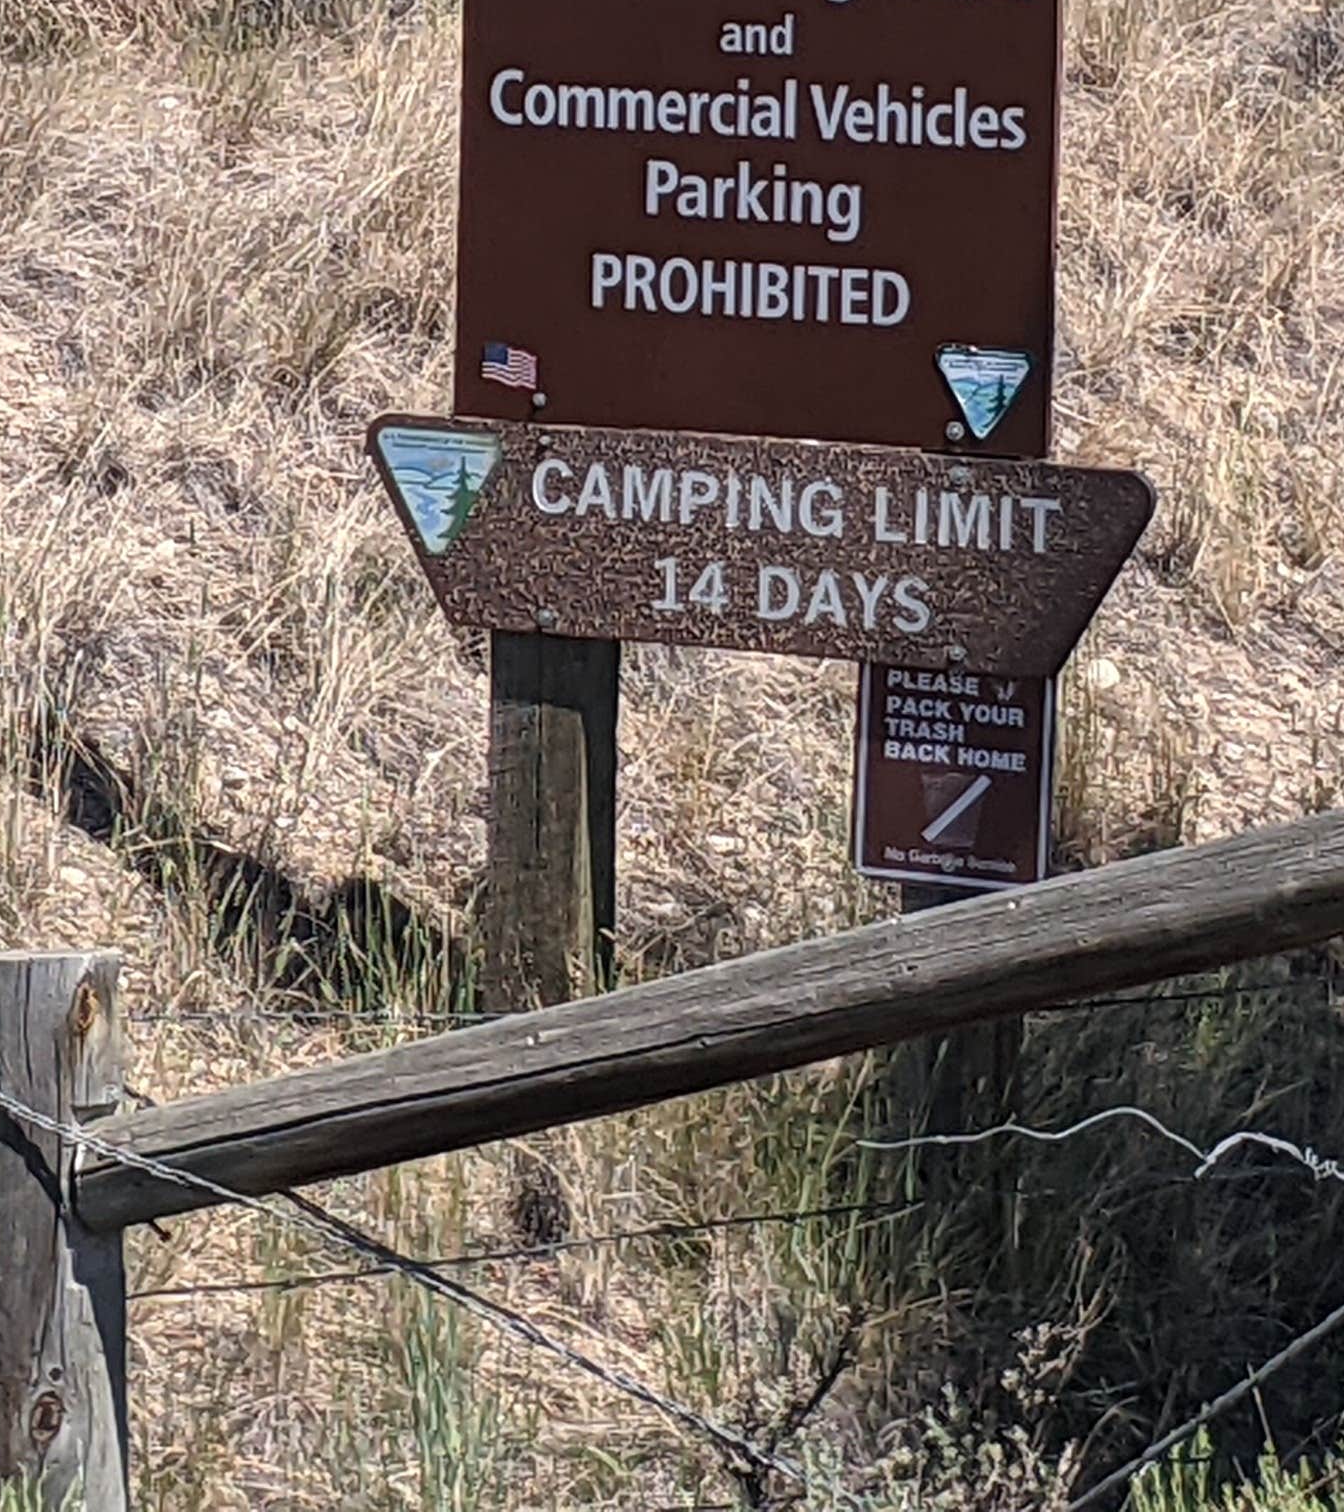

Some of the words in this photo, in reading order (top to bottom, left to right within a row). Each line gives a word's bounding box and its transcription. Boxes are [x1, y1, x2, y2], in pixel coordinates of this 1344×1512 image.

[719, 13, 795, 56] and
[490, 68, 798, 140] Commercial
[810, 83, 1028, 150] Vehicles
[645, 159, 863, 243] Parking
[590, 252, 912, 327] PROHIBITED
[531, 458, 846, 540] CAMPING
[874, 489, 1062, 555] LIMIT
[653, 556, 730, 613] 14
[756, 564, 934, 635] DAYS
[885, 695, 953, 719] PACK
[959, 701, 1026, 728] YOUR
[887, 668, 980, 696] PLEASE
[883, 740, 951, 765] BACK
[958, 746, 1027, 772] HOME
[884, 716, 965, 743] TRASH
